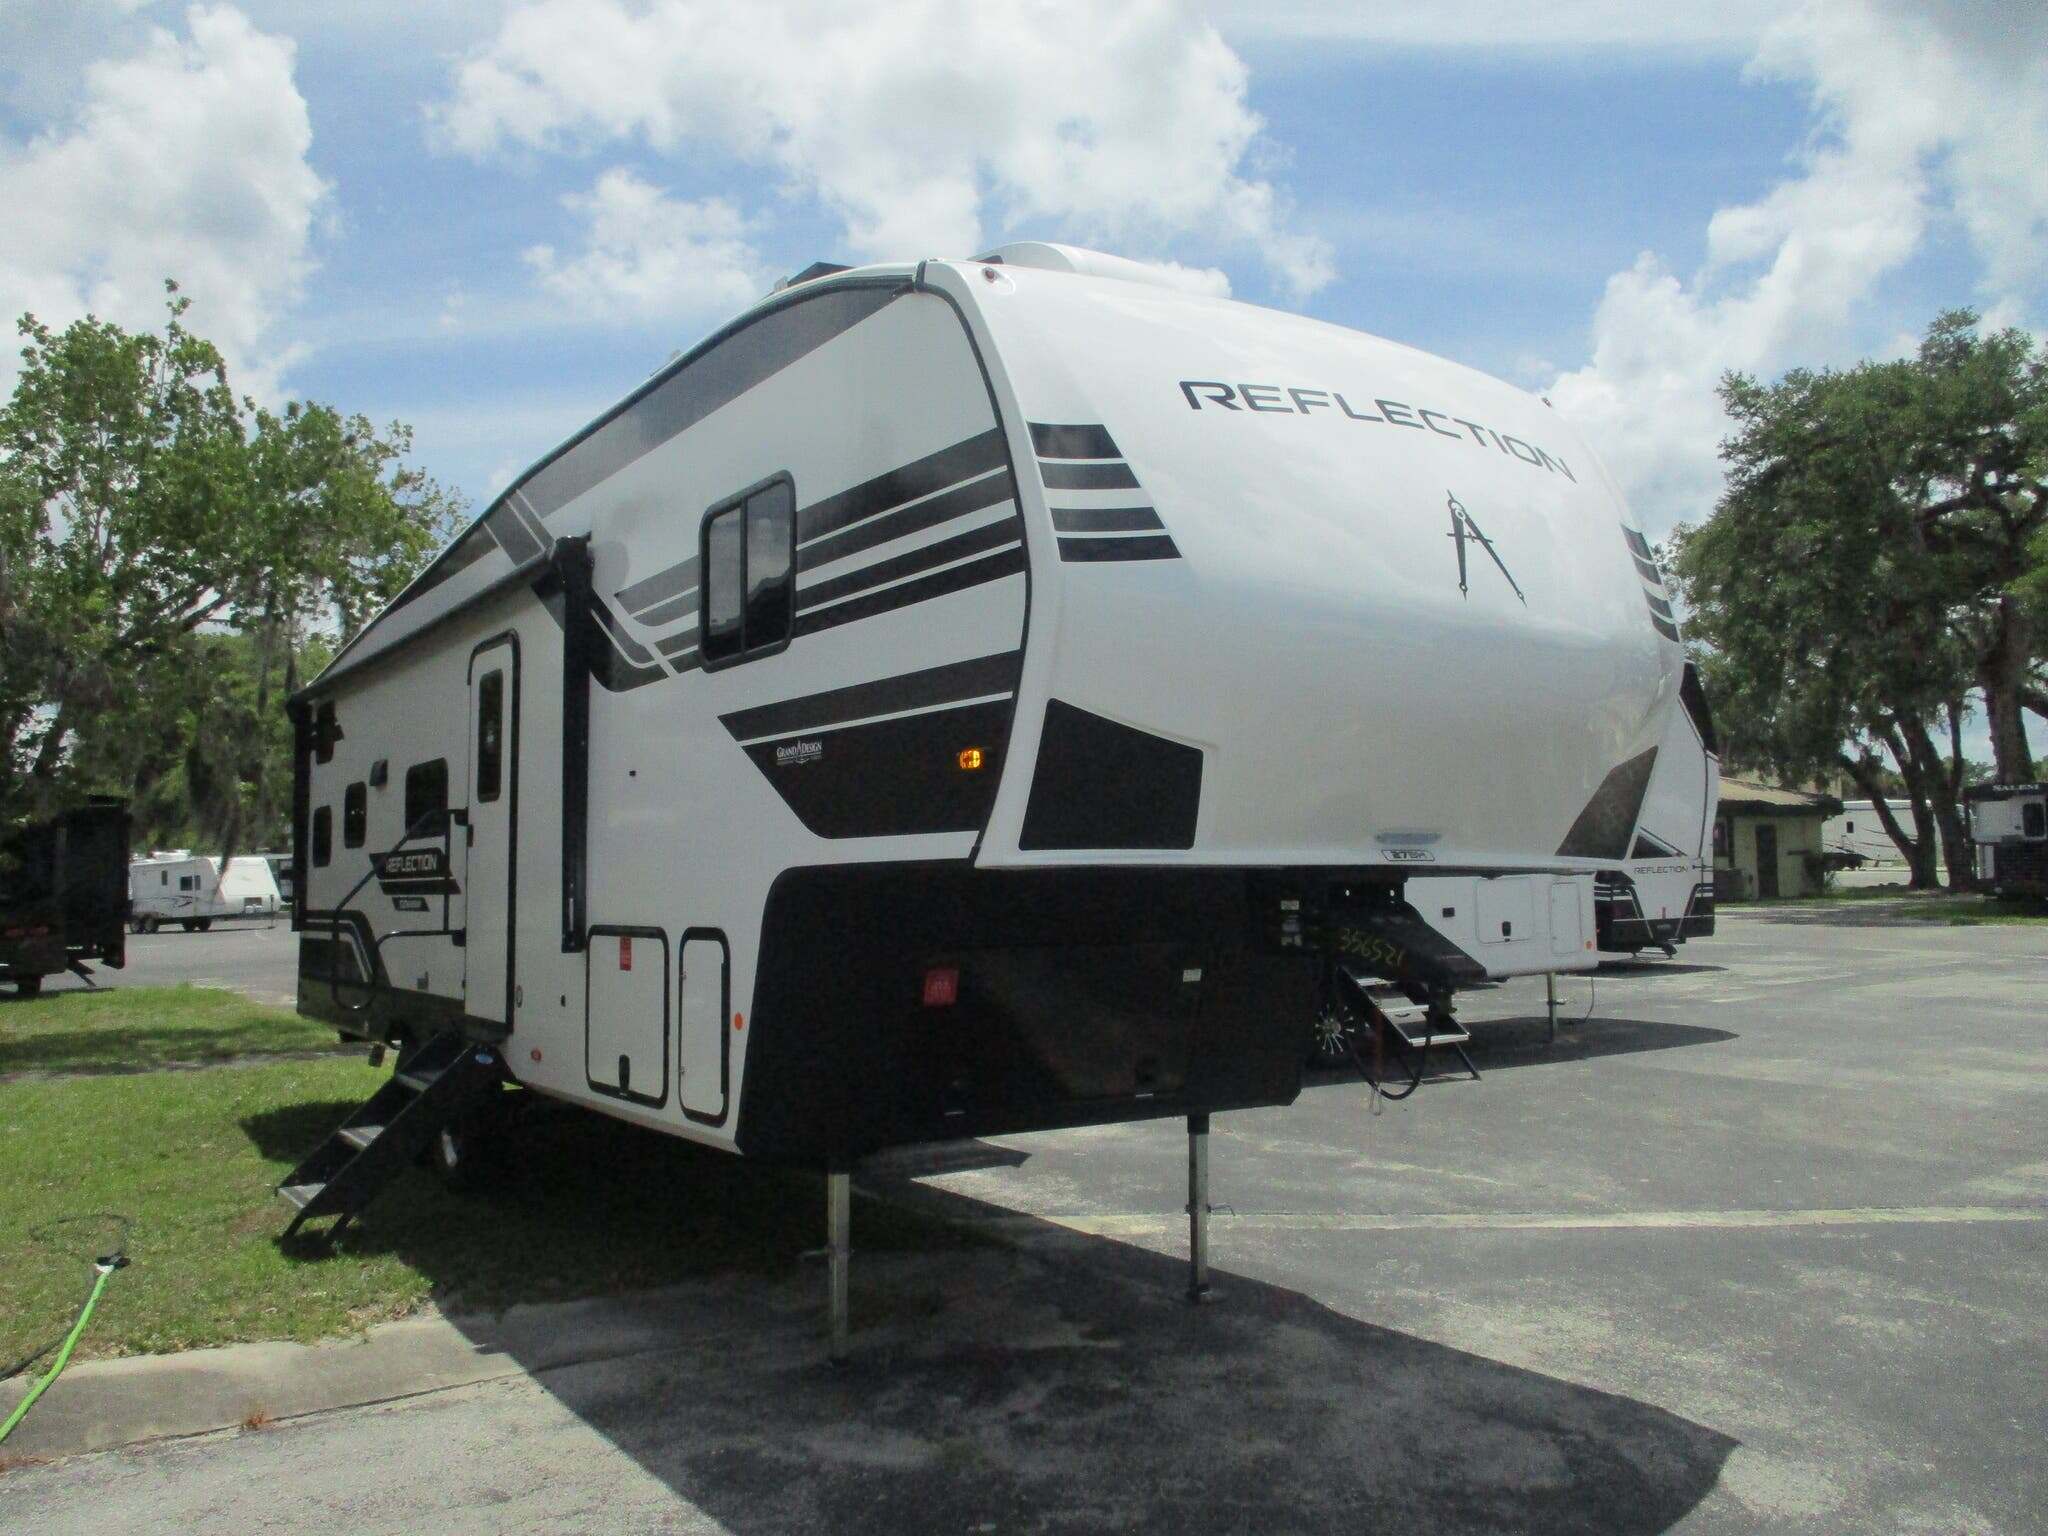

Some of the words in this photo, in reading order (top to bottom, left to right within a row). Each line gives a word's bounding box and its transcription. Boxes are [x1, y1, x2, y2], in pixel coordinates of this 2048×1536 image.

[1179, 380, 1577, 483] REFLECTION
[776, 745, 798, 758] GRAND
[801, 740, 823, 754] DESIGN
[385, 853, 437, 873] REFLECTION
[1633, 864, 1689, 875] REFLECTION
